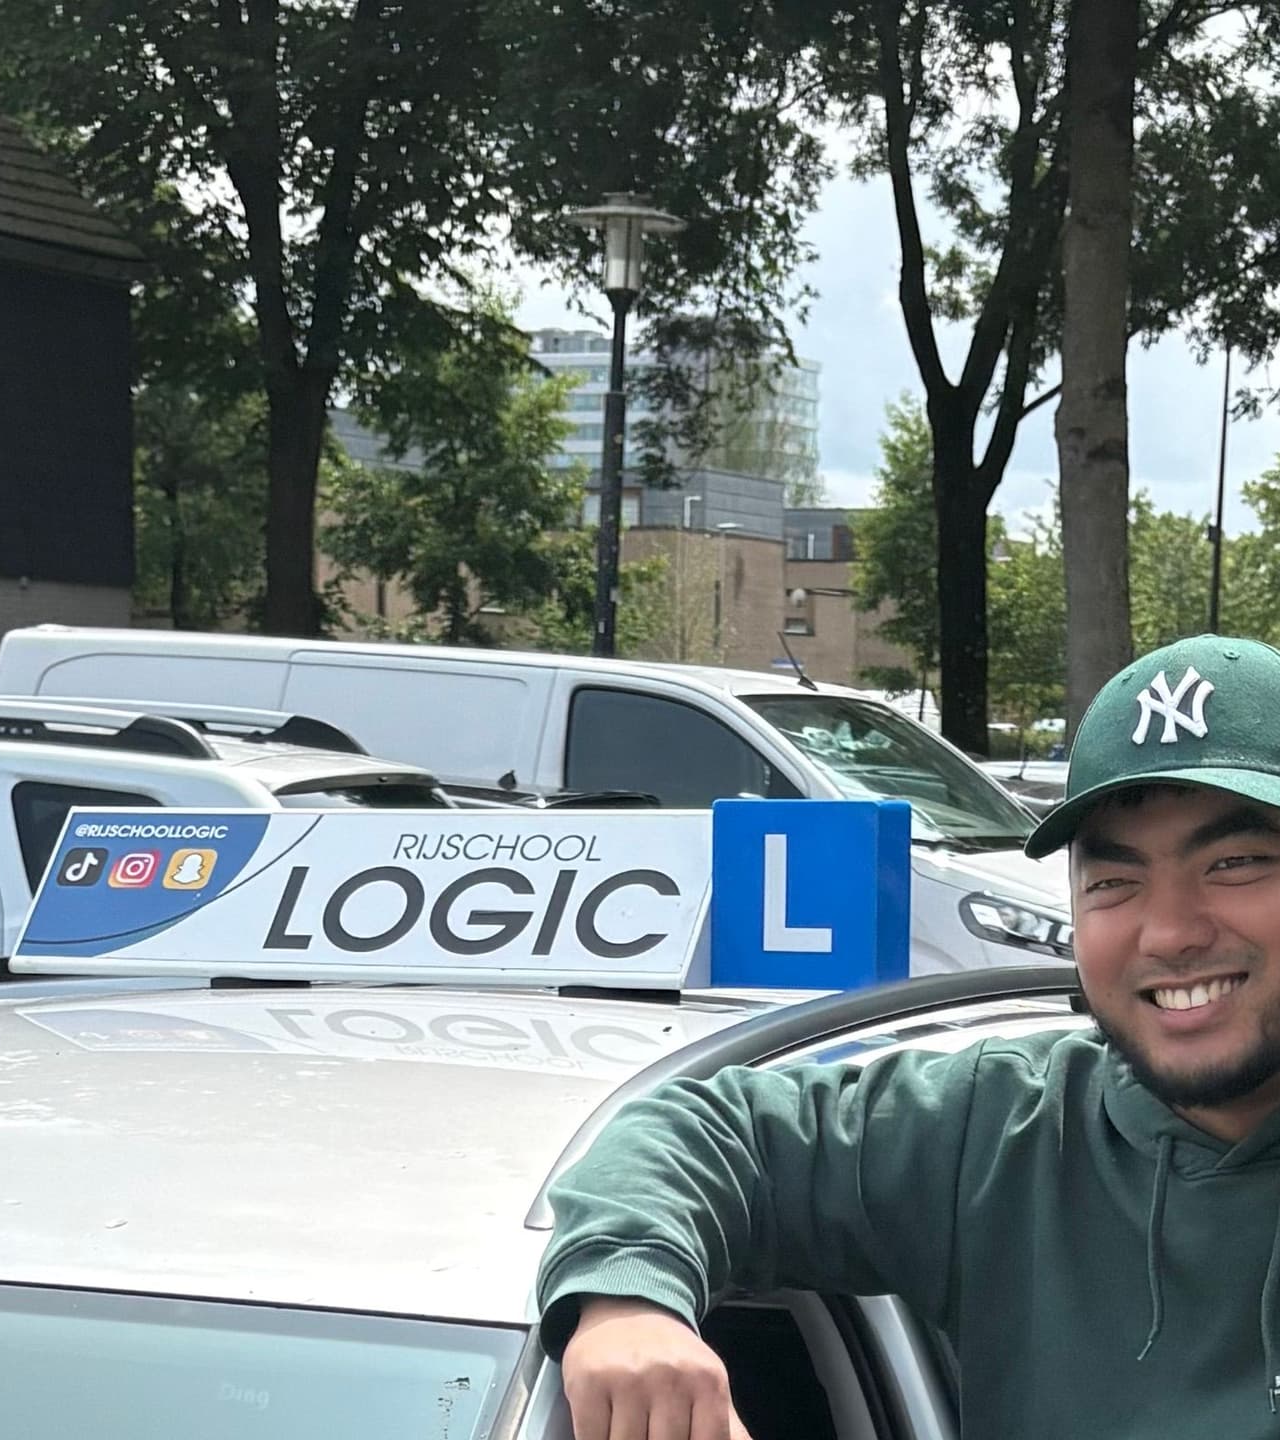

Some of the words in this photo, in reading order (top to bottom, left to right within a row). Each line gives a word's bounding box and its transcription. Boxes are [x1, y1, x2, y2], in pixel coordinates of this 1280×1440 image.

[1132, 666, 1215, 744] NY
[74, 824, 229, 839] @RIJSCHOOLLOGIC
[392, 833, 602, 862] RIJSCHOOL
[262, 865, 681, 959] LOGIC
[763, 833, 833, 953] L
